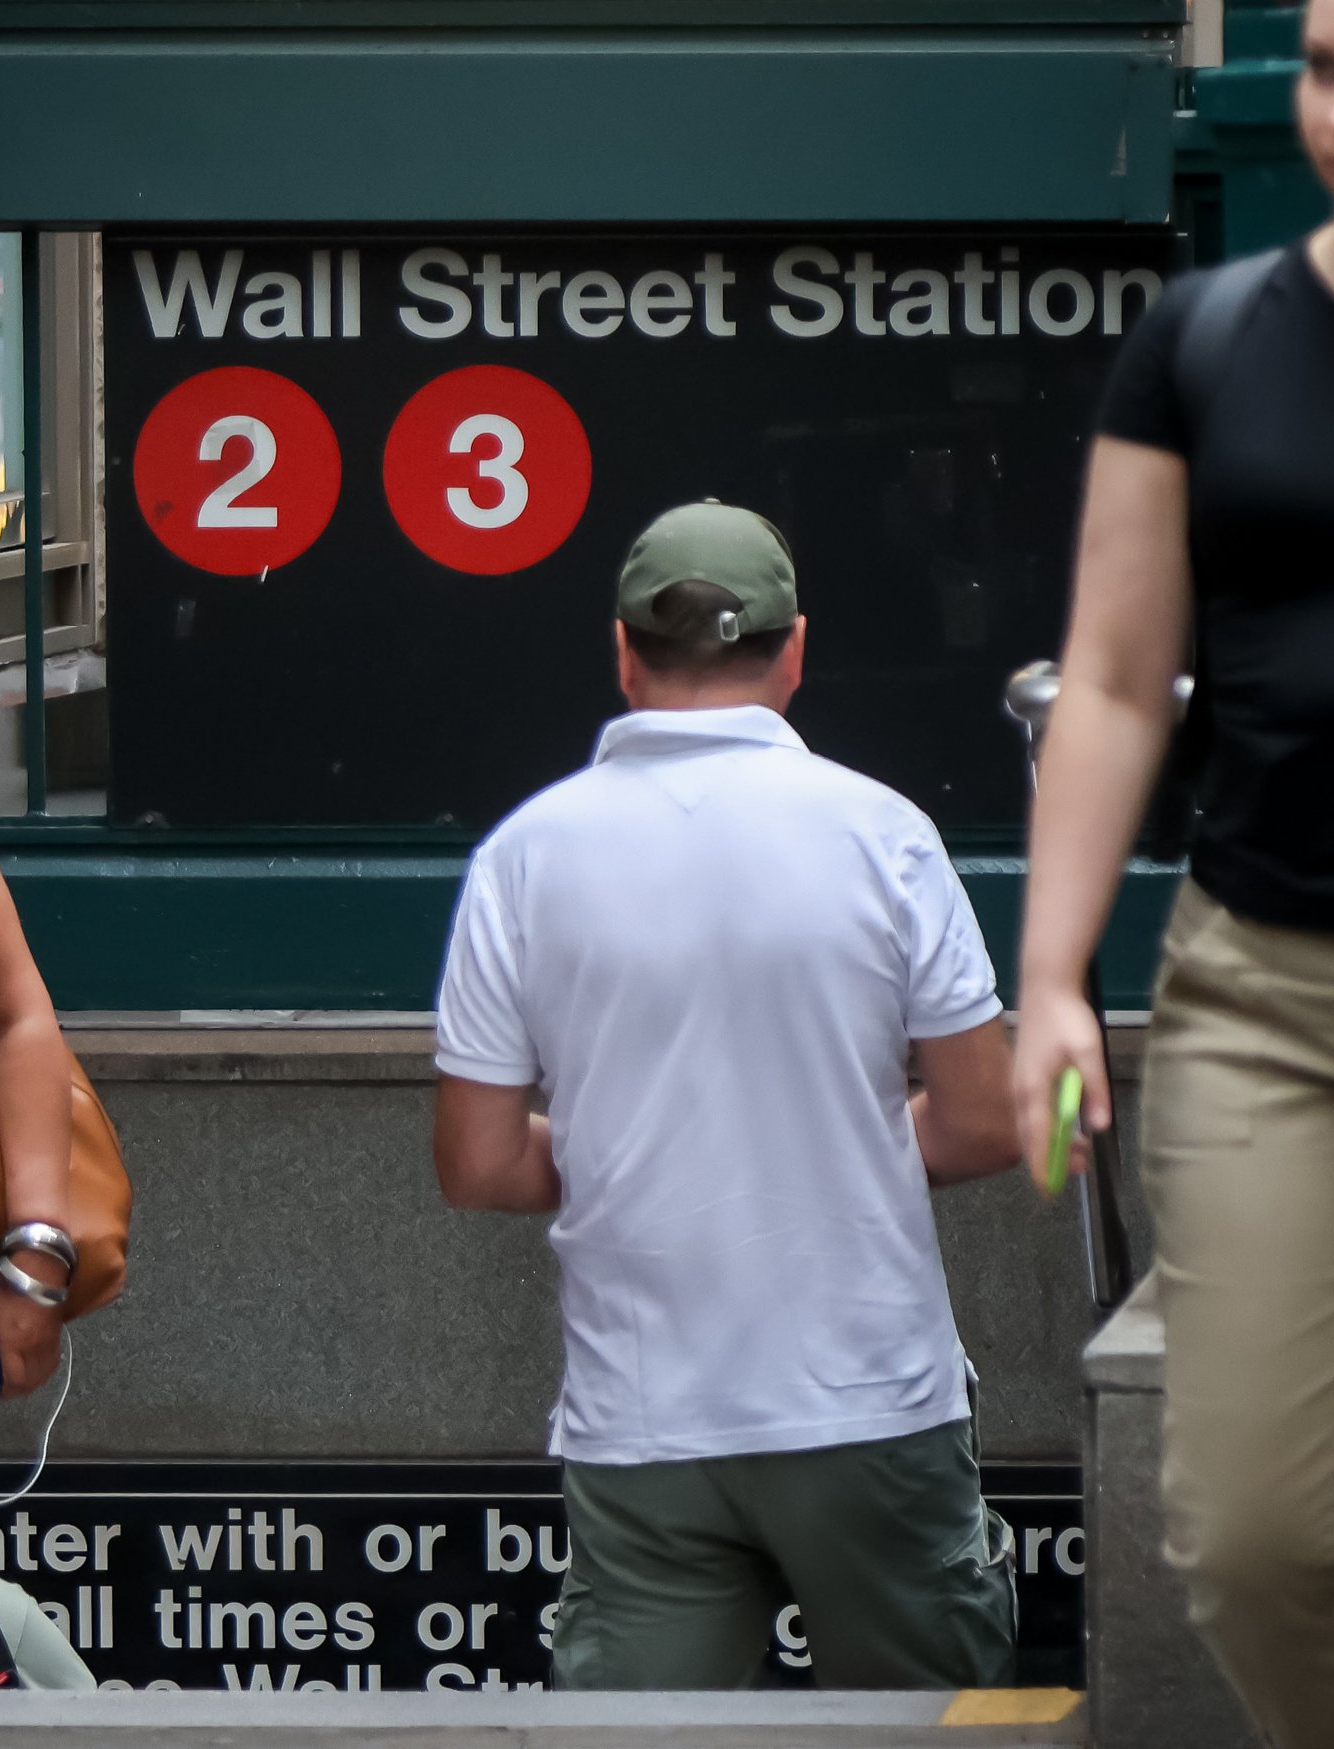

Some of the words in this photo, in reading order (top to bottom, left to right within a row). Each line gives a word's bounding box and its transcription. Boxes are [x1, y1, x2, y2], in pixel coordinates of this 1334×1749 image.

[133, 249, 361, 339] Wall
[399, 247, 737, 339] Street
[769, 246, 1164, 338] Station
[197, 414, 278, 529] 2
[447, 413, 530, 529] 3
[159, 1507, 324, 1572] with
[364, 1523, 446, 1573] or
[486, 1508, 573, 1573] bu
[153, 1585, 376, 1651] times
[416, 1602, 499, 1651] or
